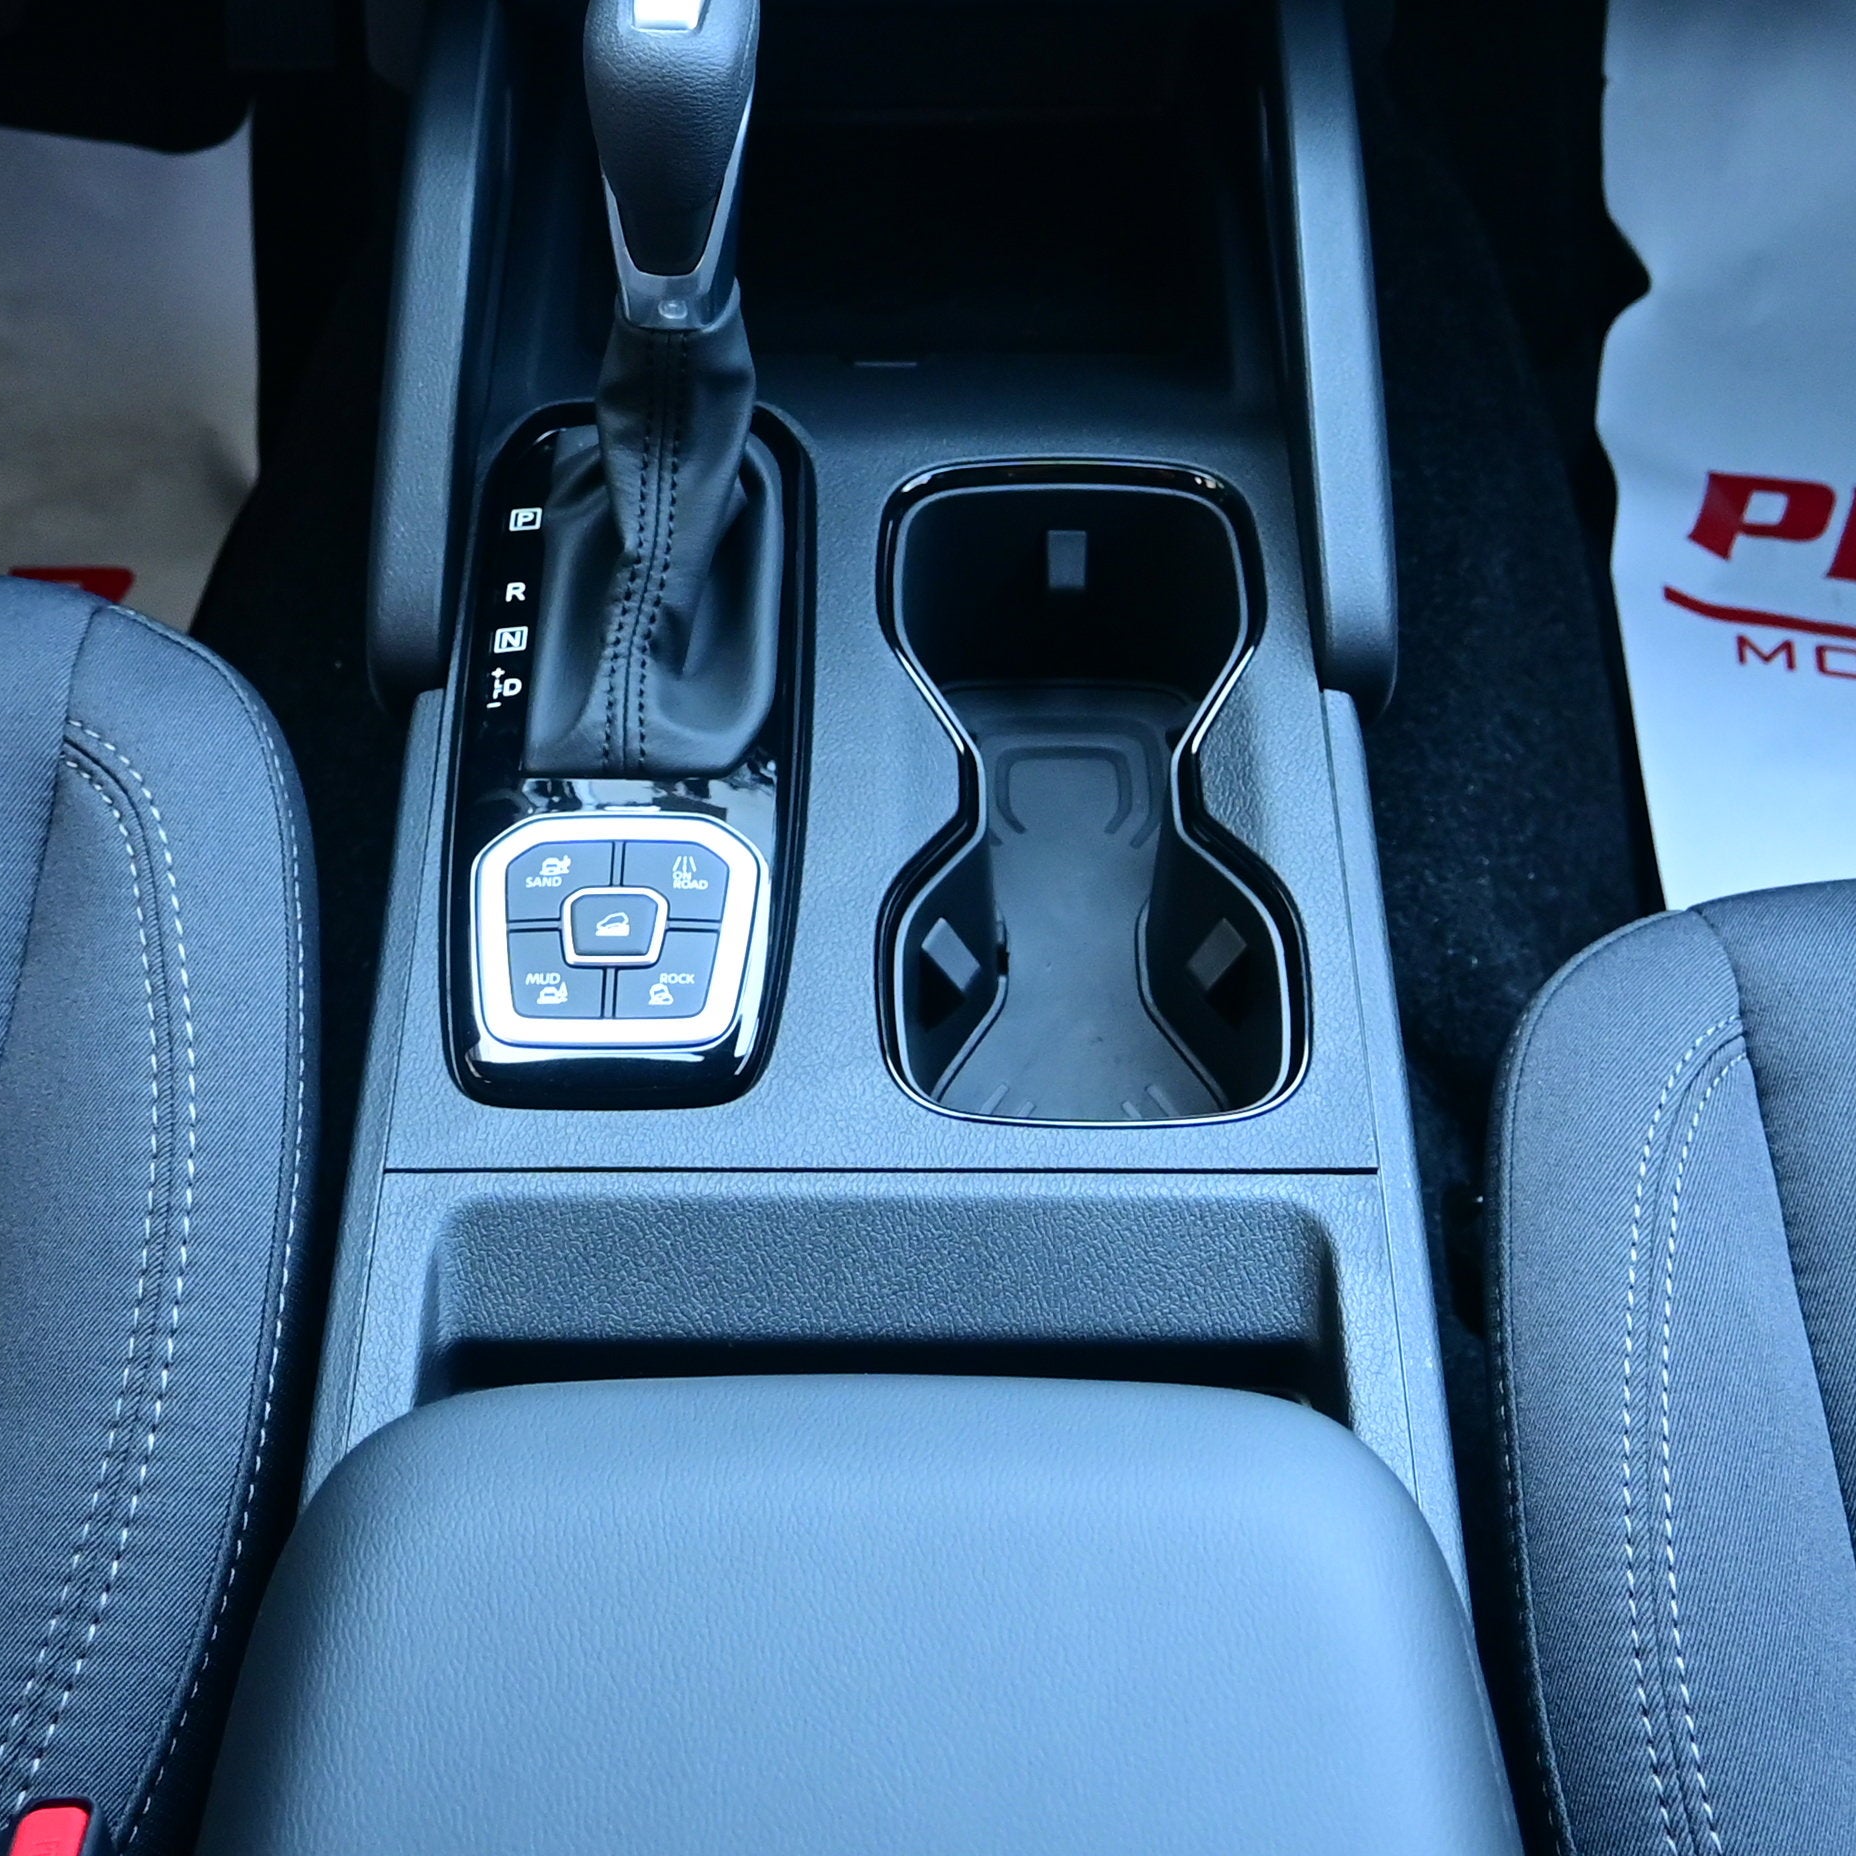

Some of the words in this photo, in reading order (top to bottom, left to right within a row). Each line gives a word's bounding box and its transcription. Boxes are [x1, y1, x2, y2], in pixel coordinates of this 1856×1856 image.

[518, 512, 534, 527] P
[506, 582, 526, 601] R
[502, 630, 521, 648] N
[504, 678, 522, 696] D
[525, 876, 562, 888] SAND
[672, 871, 692, 881] ON
[672, 879, 708, 890] ROAD
[526, 973, 560, 985] MUD
[660, 973, 695, 985] ROCK
